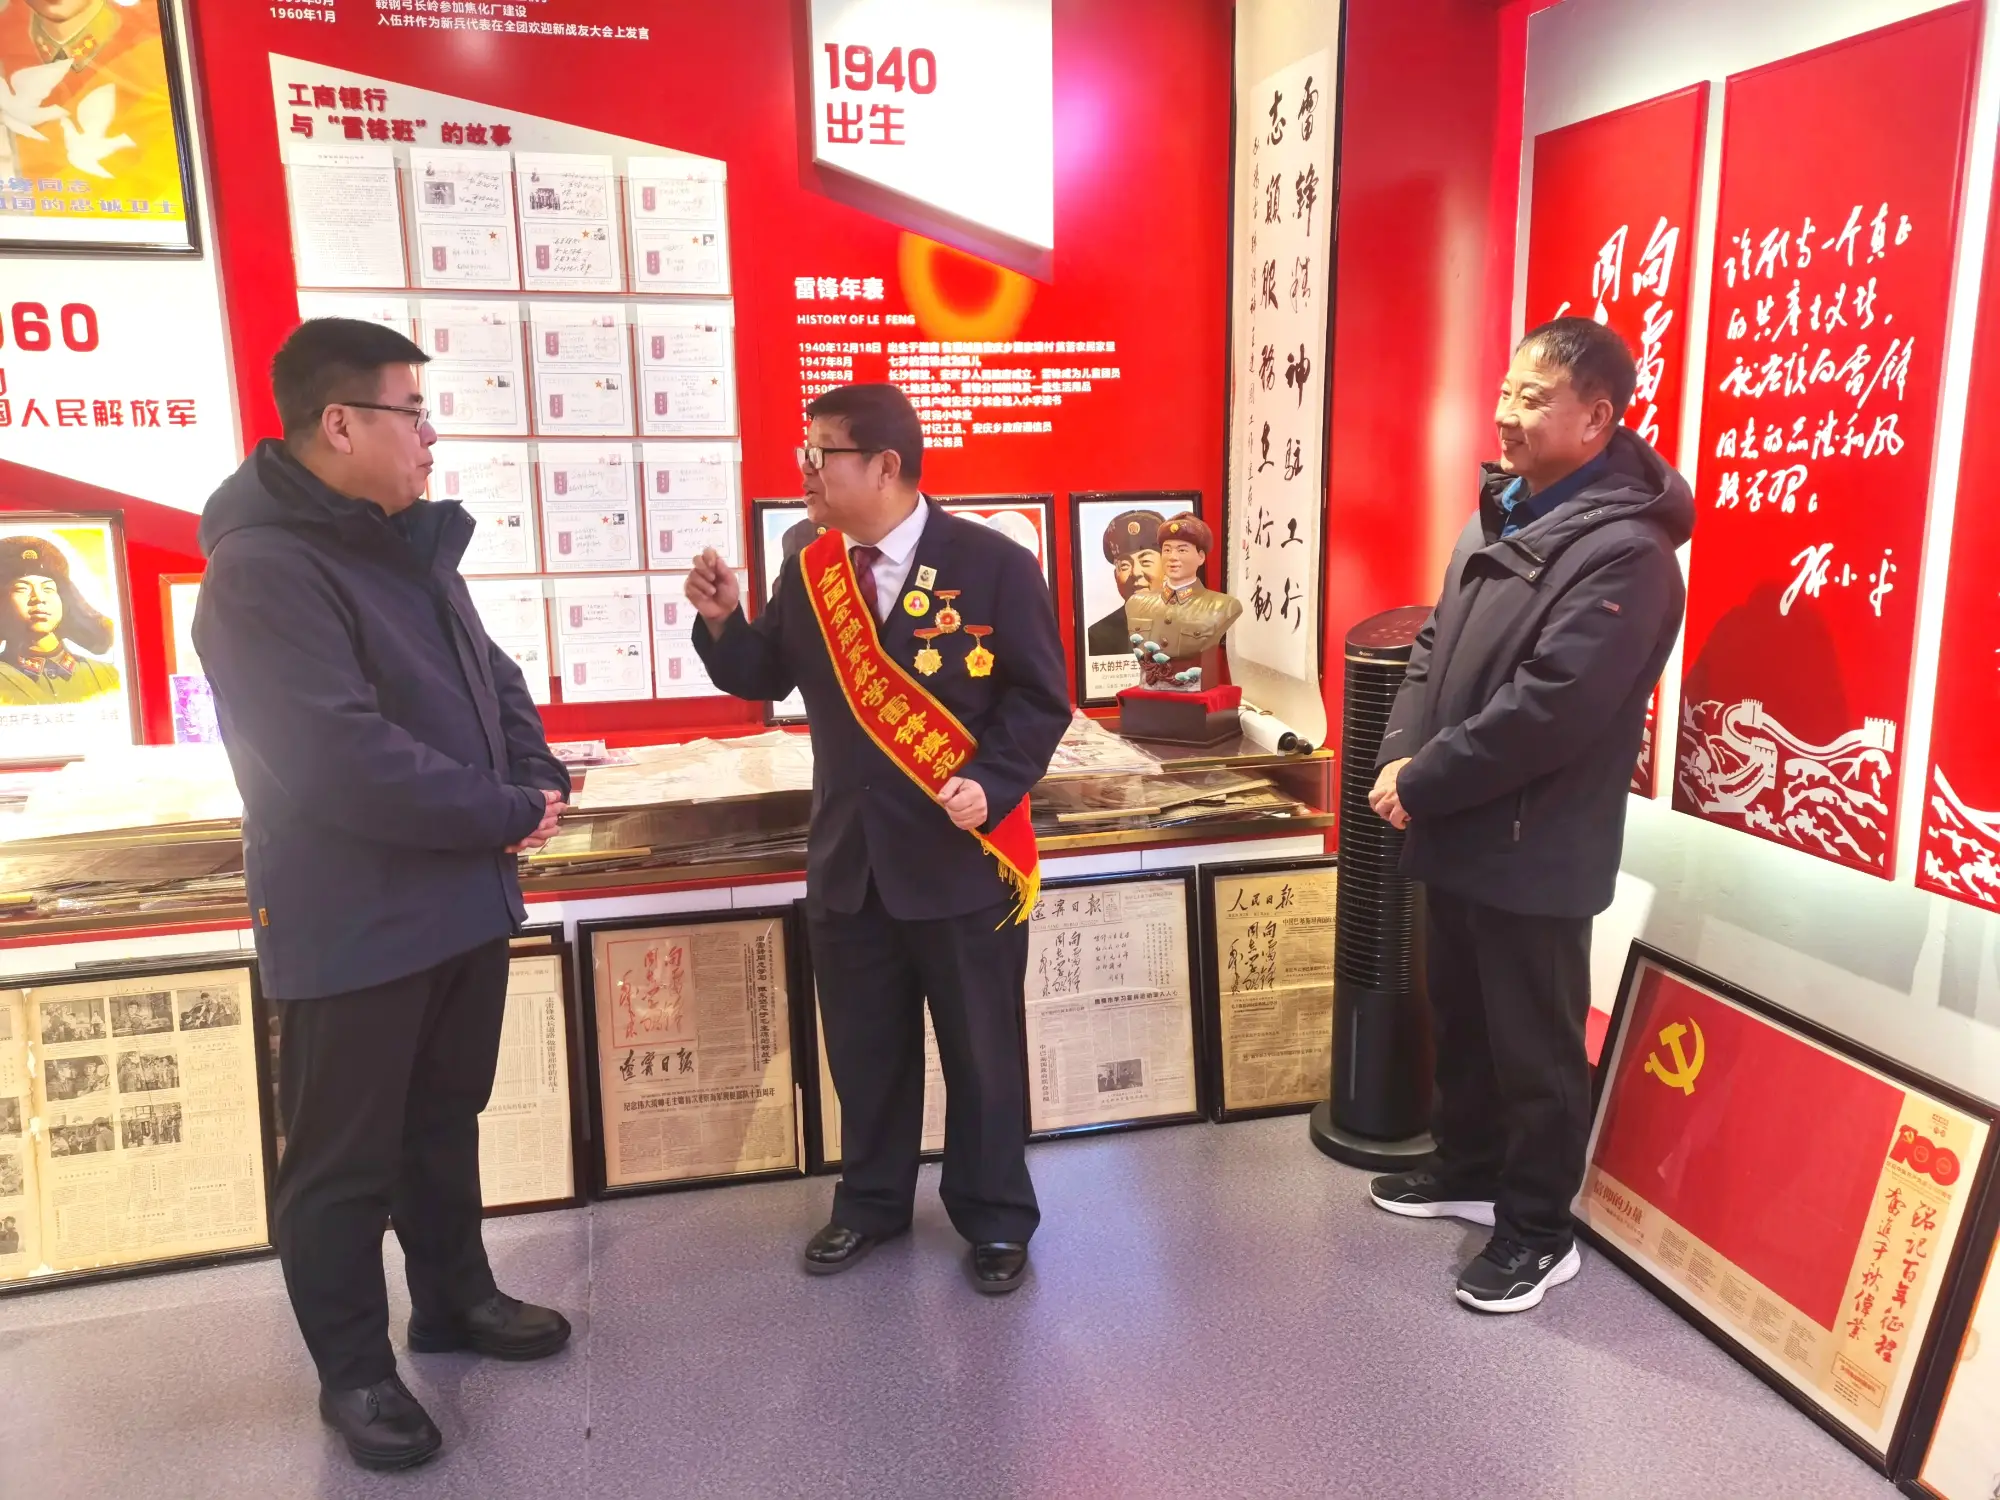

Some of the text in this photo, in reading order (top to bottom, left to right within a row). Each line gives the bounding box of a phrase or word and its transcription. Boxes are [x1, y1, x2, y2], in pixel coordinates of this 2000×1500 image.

[270, 7, 650, 40] 1960年1月 入伍并作为新兵代表在全团欢迎新战友大会上发言
[825, 43, 937, 94] 1940
[287, 82, 388, 113] 工商银行
[827, 102, 905, 145] 出生
[794, 277, 884, 300] 雷锋年表
[0, 301, 99, 352] 60
[797, 314, 847, 325] HISTORY
[849, 314, 864, 325] OF
[885, 314, 916, 325] FENG
[799, 342, 882, 354] 1940年12月18日
[800, 356, 853, 367] 1947年8月
[800, 370, 853, 381] 1949年8月
[816, 561, 966, 780] 全国金融系统学雷锋模范
[1091, 660, 1140, 672] 伟大的共产主
